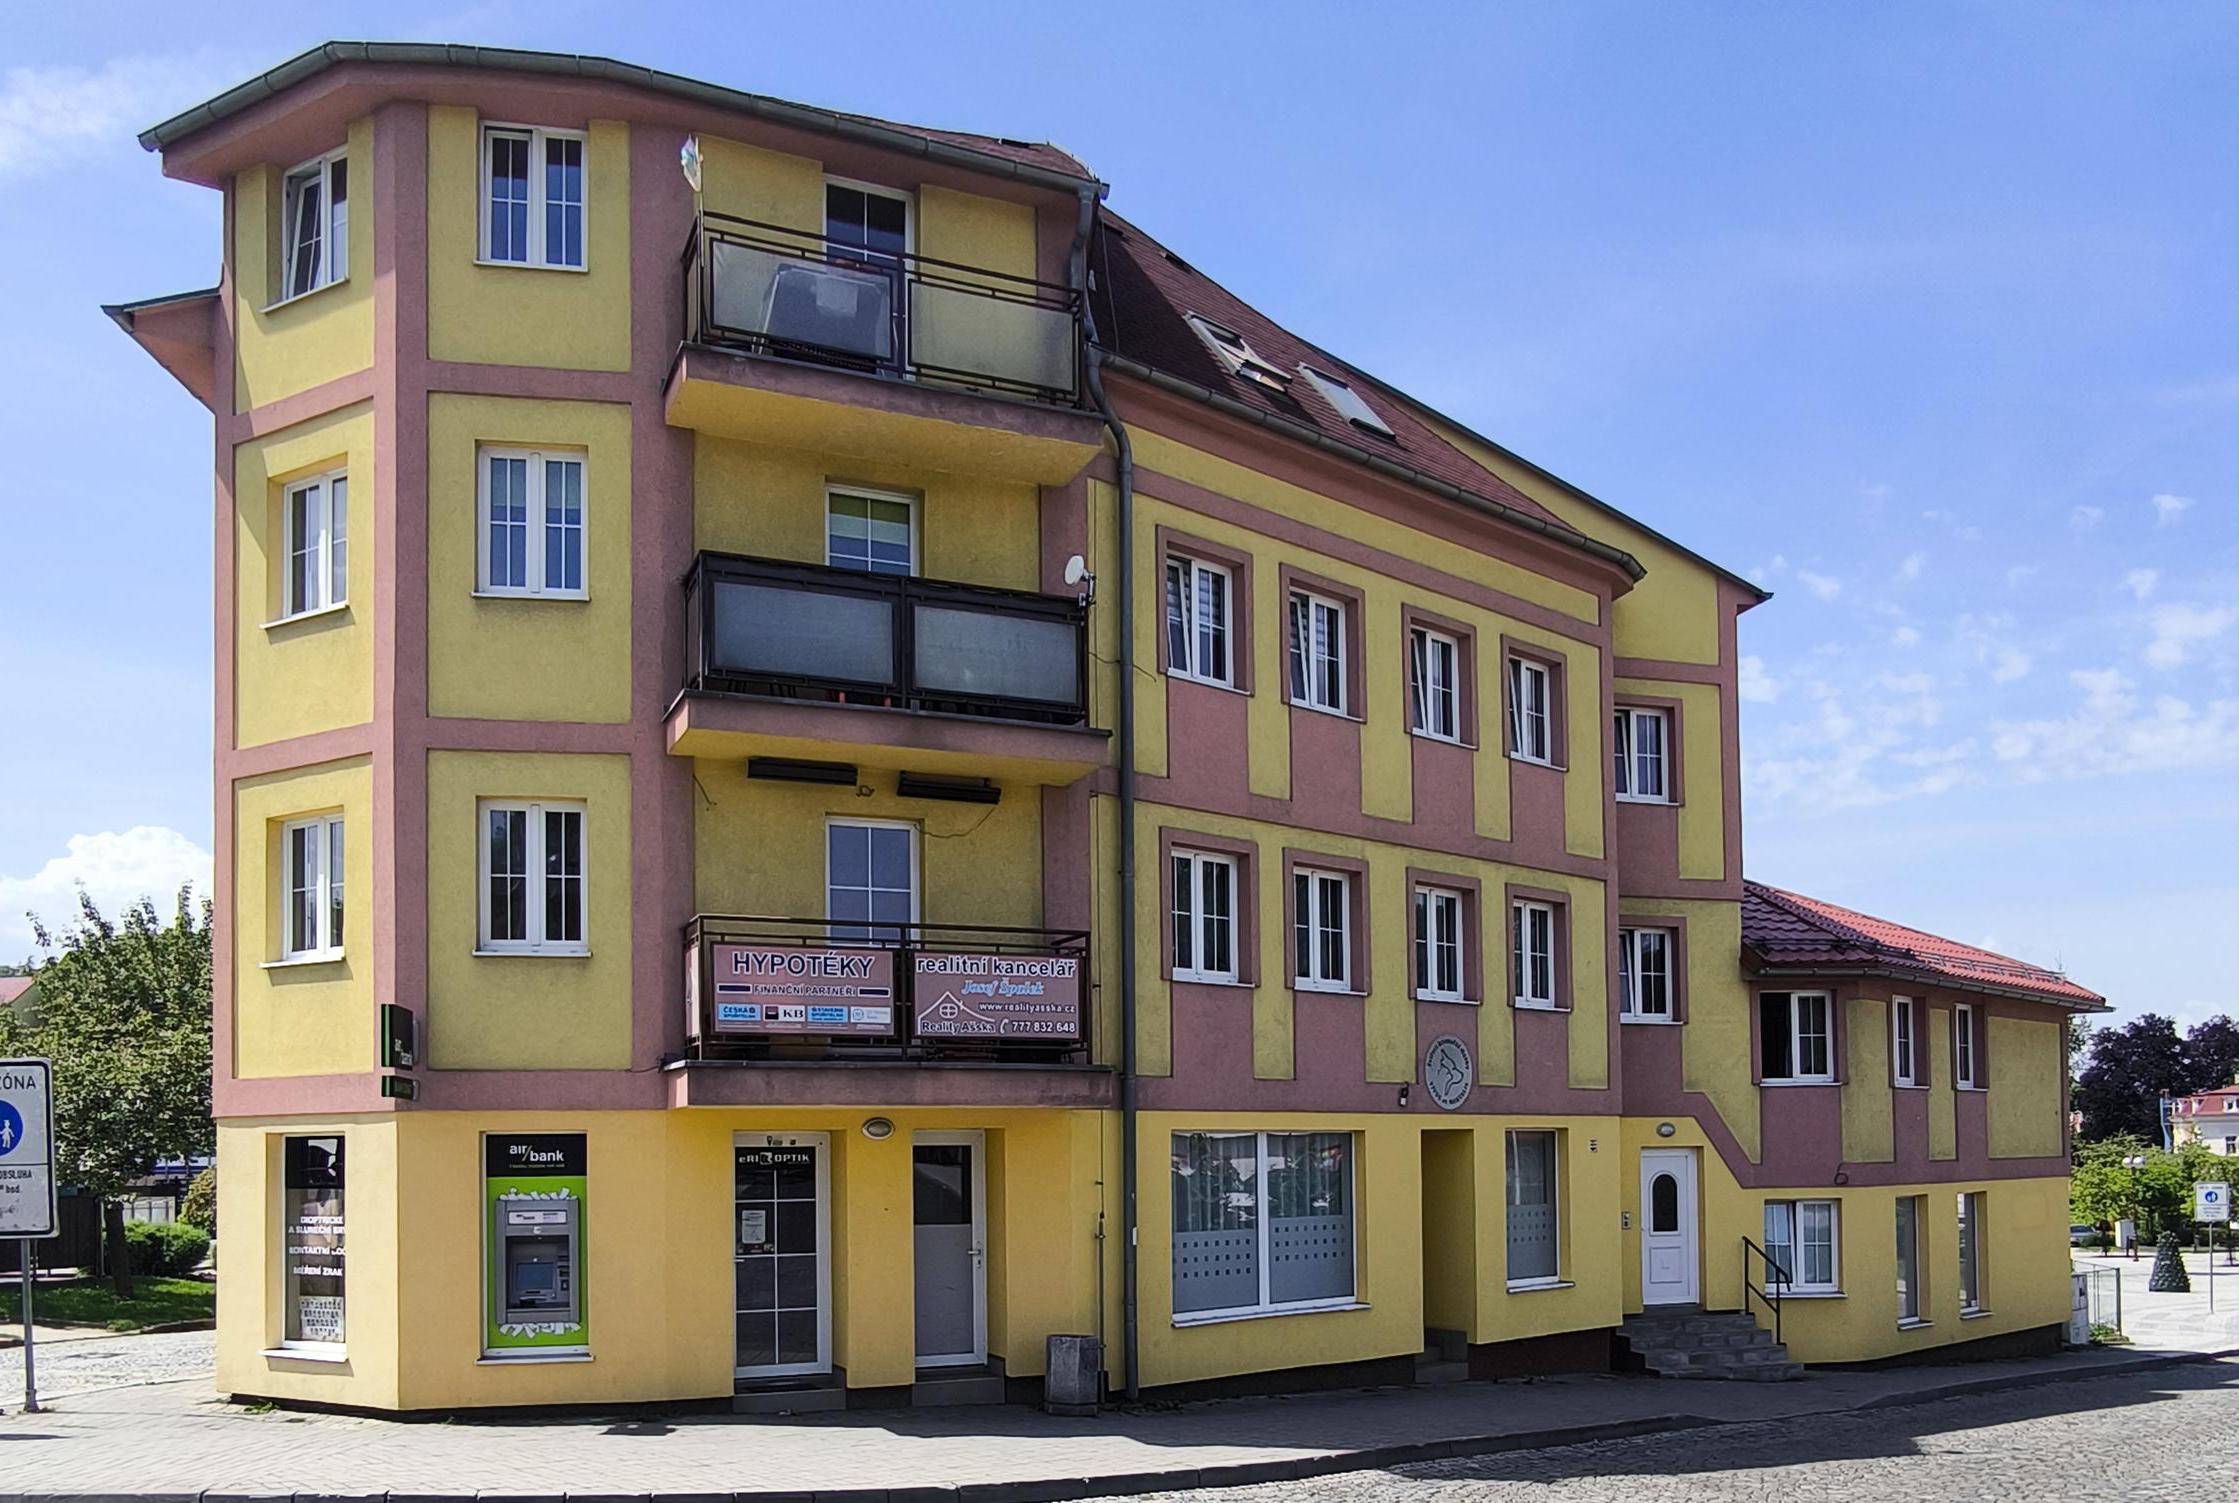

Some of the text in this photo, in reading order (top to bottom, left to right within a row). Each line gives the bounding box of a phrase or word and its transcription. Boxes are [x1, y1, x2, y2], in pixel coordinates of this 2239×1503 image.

[733, 951, 875, 978] HYPOTÉKY
[916, 955, 1077, 977] realitní kancelář
[754, 983, 857, 996] FINANČNÍ PARTNEŘI
[783, 1009, 804, 1018] KB
[922, 1020, 959, 1035] Reality
[1012, 1021, 1076, 1033] 777 832 648
[0, 1072, 36, 1090] ÓNA
[510, 1145, 565, 1161] air bank
[774, 1154, 810, 1162] OPTIK
